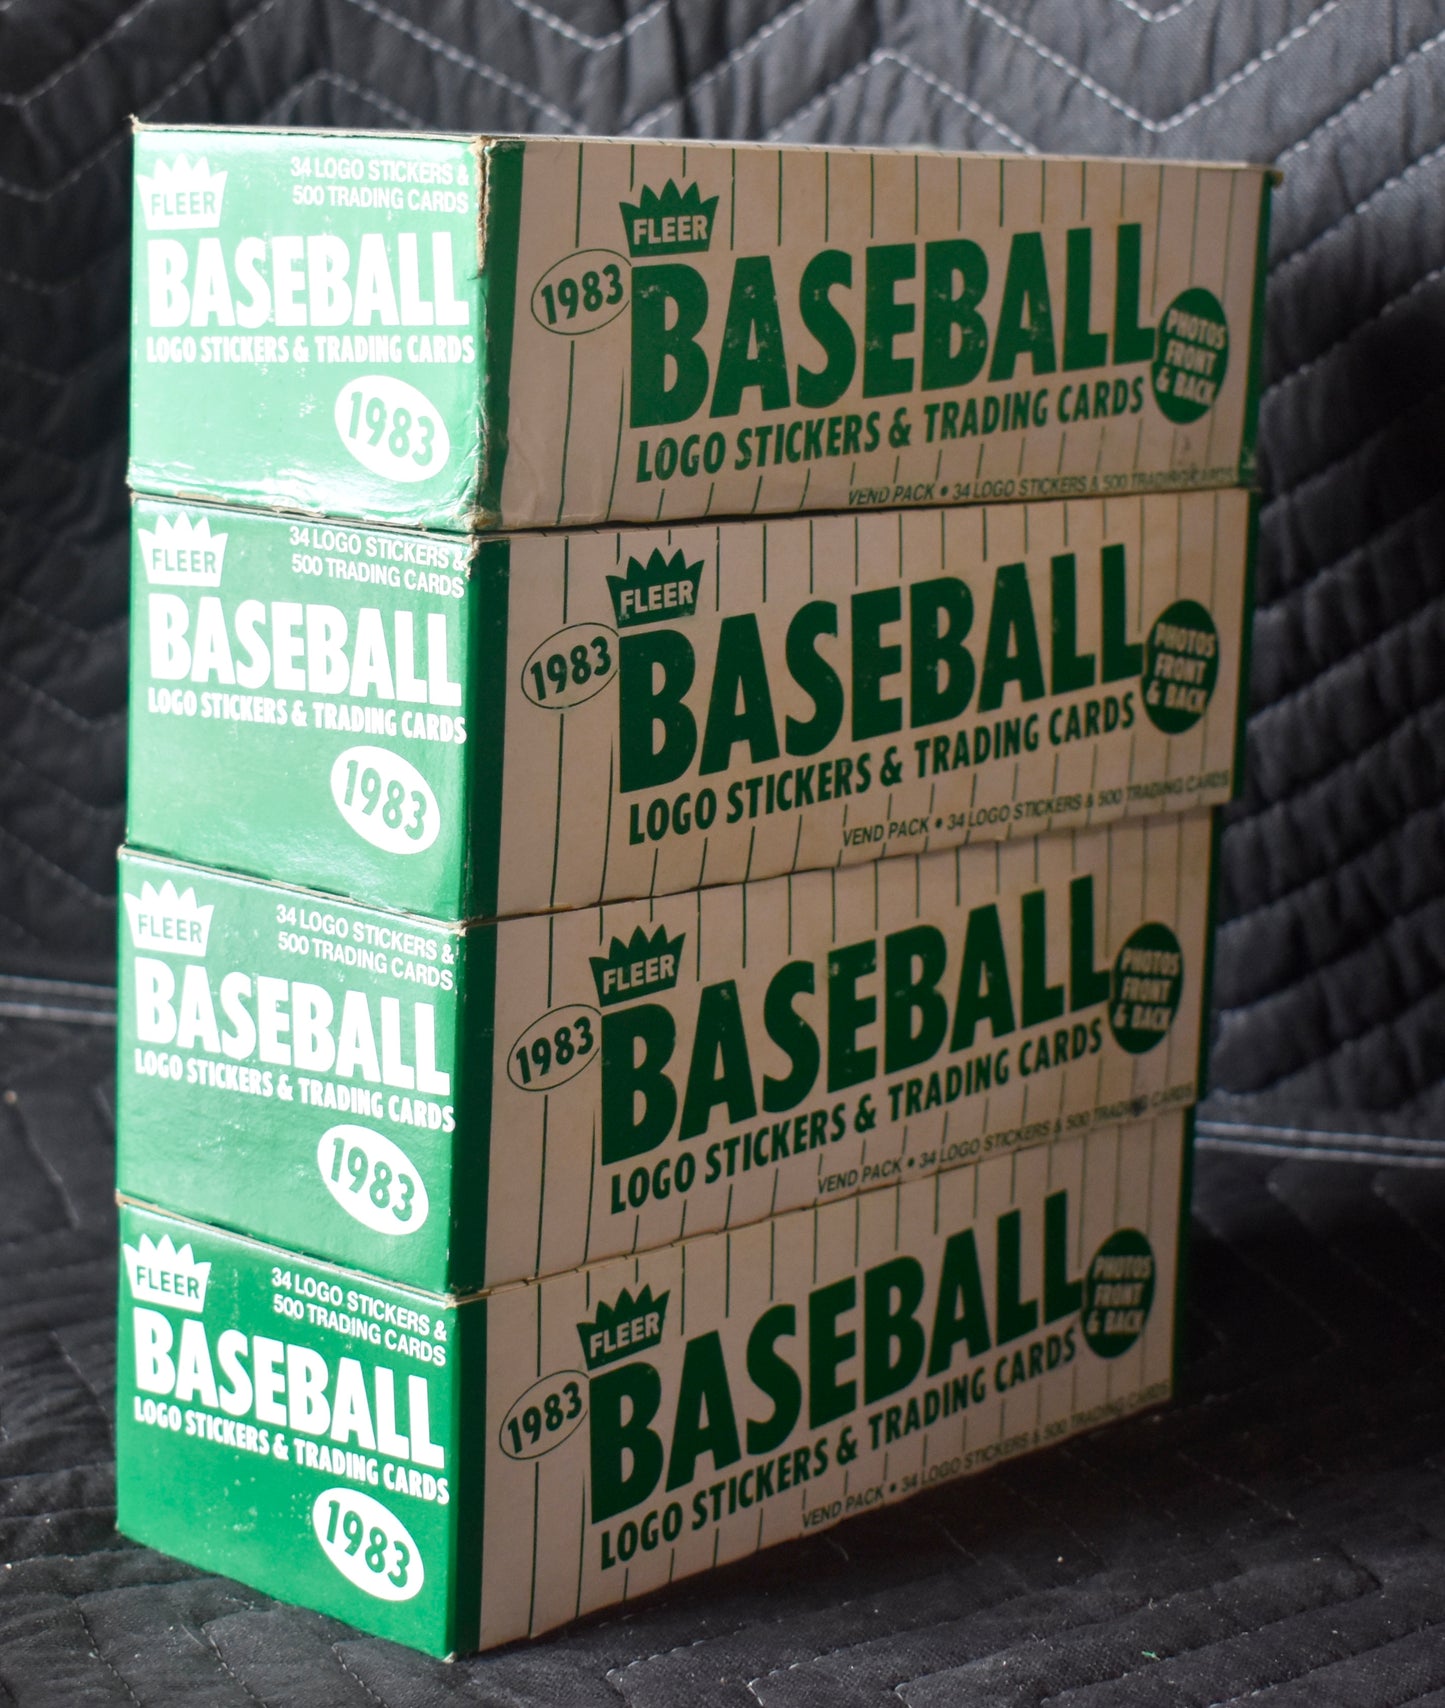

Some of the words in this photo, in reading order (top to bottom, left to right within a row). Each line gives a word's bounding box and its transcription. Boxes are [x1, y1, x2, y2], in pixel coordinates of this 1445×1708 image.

[291, 157, 311, 177] 34
[314, 158, 364, 181] LOGO
[368, 160, 453, 184] STICKERS
[457, 164, 469, 185] &
[293, 185, 324, 206] 500
[328, 186, 403, 209] TRADING
[408, 190, 468, 213] CARDS
[151, 191, 216, 216] FLEER
[633, 215, 708, 245] FLEER
[148, 232, 469, 329] BASEBALL
[541, 264, 623, 325] 1983
[147, 336, 196, 363] LOGO
[200, 336, 289, 363] STICKERS
[293, 337, 310, 362] &
[315, 336, 401, 363] TRADING
[407, 336, 475, 363] CARDS
[630, 222, 1156, 428] BASEBALL
[1165, 308, 1227, 349] PHOTOS
[1155, 366, 1171, 392] &
[1173, 372, 1215, 407] BACK
[1165, 341, 1217, 375] FRONT
[350, 391, 435, 466] 1983
[636, 431, 725, 482] LOGO
[735, 411, 881, 471] STICKERS
[888, 407, 912, 448] &
[925, 388, 1049, 443] TRADING
[1058, 376, 1144, 423] CARDS
[848, 484, 890, 506] VEND
[894, 483, 935, 500] PACK
[953, 481, 971, 499] 34
[974, 480, 1015, 498] LOGO
[1019, 475, 1088, 495] STICKERS
[1103, 473, 1127, 489] 500
[152, 548, 216, 573] FLEER
[290, 526, 309, 546] 34
[313, 530, 361, 555] LOGO
[365, 537, 449, 569] STICKERS
[452, 549, 466, 570] &
[292, 554, 323, 576] 500
[327, 558, 400, 588] TRADING
[404, 569, 464, 598] CARDS
[620, 580, 694, 616] FLEER
[148, 593, 461, 706] BASEBALL
[530, 636, 612, 701] 1983
[619, 543, 1144, 794] BASEBALL
[1155, 623, 1216, 658] PHOTOS
[1156, 653, 1206, 682] FRONT
[148, 688, 197, 716] LOGO
[201, 692, 288, 725] STICKERS
[292, 701, 307, 726] &
[315, 702, 397, 736] TRADING
[401, 712, 467, 744] CARDS
[1146, 681, 1161, 706] &
[1165, 688, 1207, 715] BACK
[629, 788, 716, 846] LOGO
[726, 752, 871, 824] STICKERS
[880, 746, 903, 786] &
[915, 713, 1039, 779] TRADING
[1049, 692, 1135, 746] CARDS
[344, 760, 426, 840] 1983
[842, 823, 884, 847] VEND
[888, 818, 929, 839] PACK
[947, 813, 966, 831] 34
[968, 807, 1009, 828] LOGO
[1012, 794, 1083, 821] STICKERS
[138, 914, 201, 943] FLEER
[276, 904, 296, 925] 34
[300, 909, 348, 938] LOGO
[353, 919, 436, 960] STICKERS
[441, 942, 454, 964] &
[278, 931, 309, 955] 500
[314, 938, 387, 973] TRADING
[391, 957, 453, 990] CARDS
[603, 954, 675, 995] FLEER
[1121, 948, 1180, 973] PHOTOS
[1121, 976, 1172, 1003] FRONT
[134, 957, 450, 1096] BASEBALL
[601, 874, 1110, 1166] BASEBALL
[1114, 1009, 1128, 1028] &
[1131, 1007, 1172, 1031] BACK
[516, 1016, 594, 1085] 1983
[135, 1048, 183, 1081] LOGO
[187, 1059, 273, 1097] STICKERS
[277, 1075, 293, 1100] &
[299, 1077, 383, 1119] TRADING
[388, 1099, 455, 1132] CARDS
[611, 1152, 696, 1215] LOGO
[705, 1103, 846, 1185] STICKERS
[854, 1095, 877, 1133] &
[888, 1049, 1010, 1122] TRADING
[1018, 1018, 1103, 1077] CARDS
[331, 1137, 415, 1222] 1983
[817, 1171, 859, 1195] VEND
[862, 1159, 901, 1181] PACK
[919, 1151, 937, 1169] 34
[939, 1141, 981, 1163] LOGO
[983, 1121, 1051, 1151] STICKERS
[136, 1264, 199, 1298] FLEER
[272, 1267, 291, 1288] 34
[294, 1274, 342, 1305] LOGO
[347, 1288, 430, 1334] STICKERS
[434, 1319, 447, 1342] &
[274, 1294, 304, 1319] 500
[307, 1302, 381, 1343] TRADING
[385, 1329, 446, 1366] CARDS
[590, 1312, 660, 1358] FLEER
[1087, 1311, 1100, 1336] &
[589, 1189, 1082, 1525] BASEBALL
[133, 1306, 444, 1468] BASEBALL
[508, 1382, 582, 1454] 1983
[134, 1396, 182, 1431] LOGO
[186, 1411, 269, 1454] STICKERS
[273, 1433, 289, 1461] &
[294, 1439, 378, 1485] TRADING
[383, 1463, 449, 1505] CARDS
[601, 1502, 683, 1570] LOGO
[692, 1438, 828, 1531] STICKERS
[836, 1427, 857, 1466] &
[868, 1367, 986, 1452] TRADING
[994, 1328, 1076, 1393] CARDS
[802, 1504, 842, 1529] VEND
[846, 1488, 883, 1510] PACK
[901, 1476, 918, 1494] 34
[921, 1460, 961, 1485] LOGO
[326, 1500, 410, 1588] 1983
